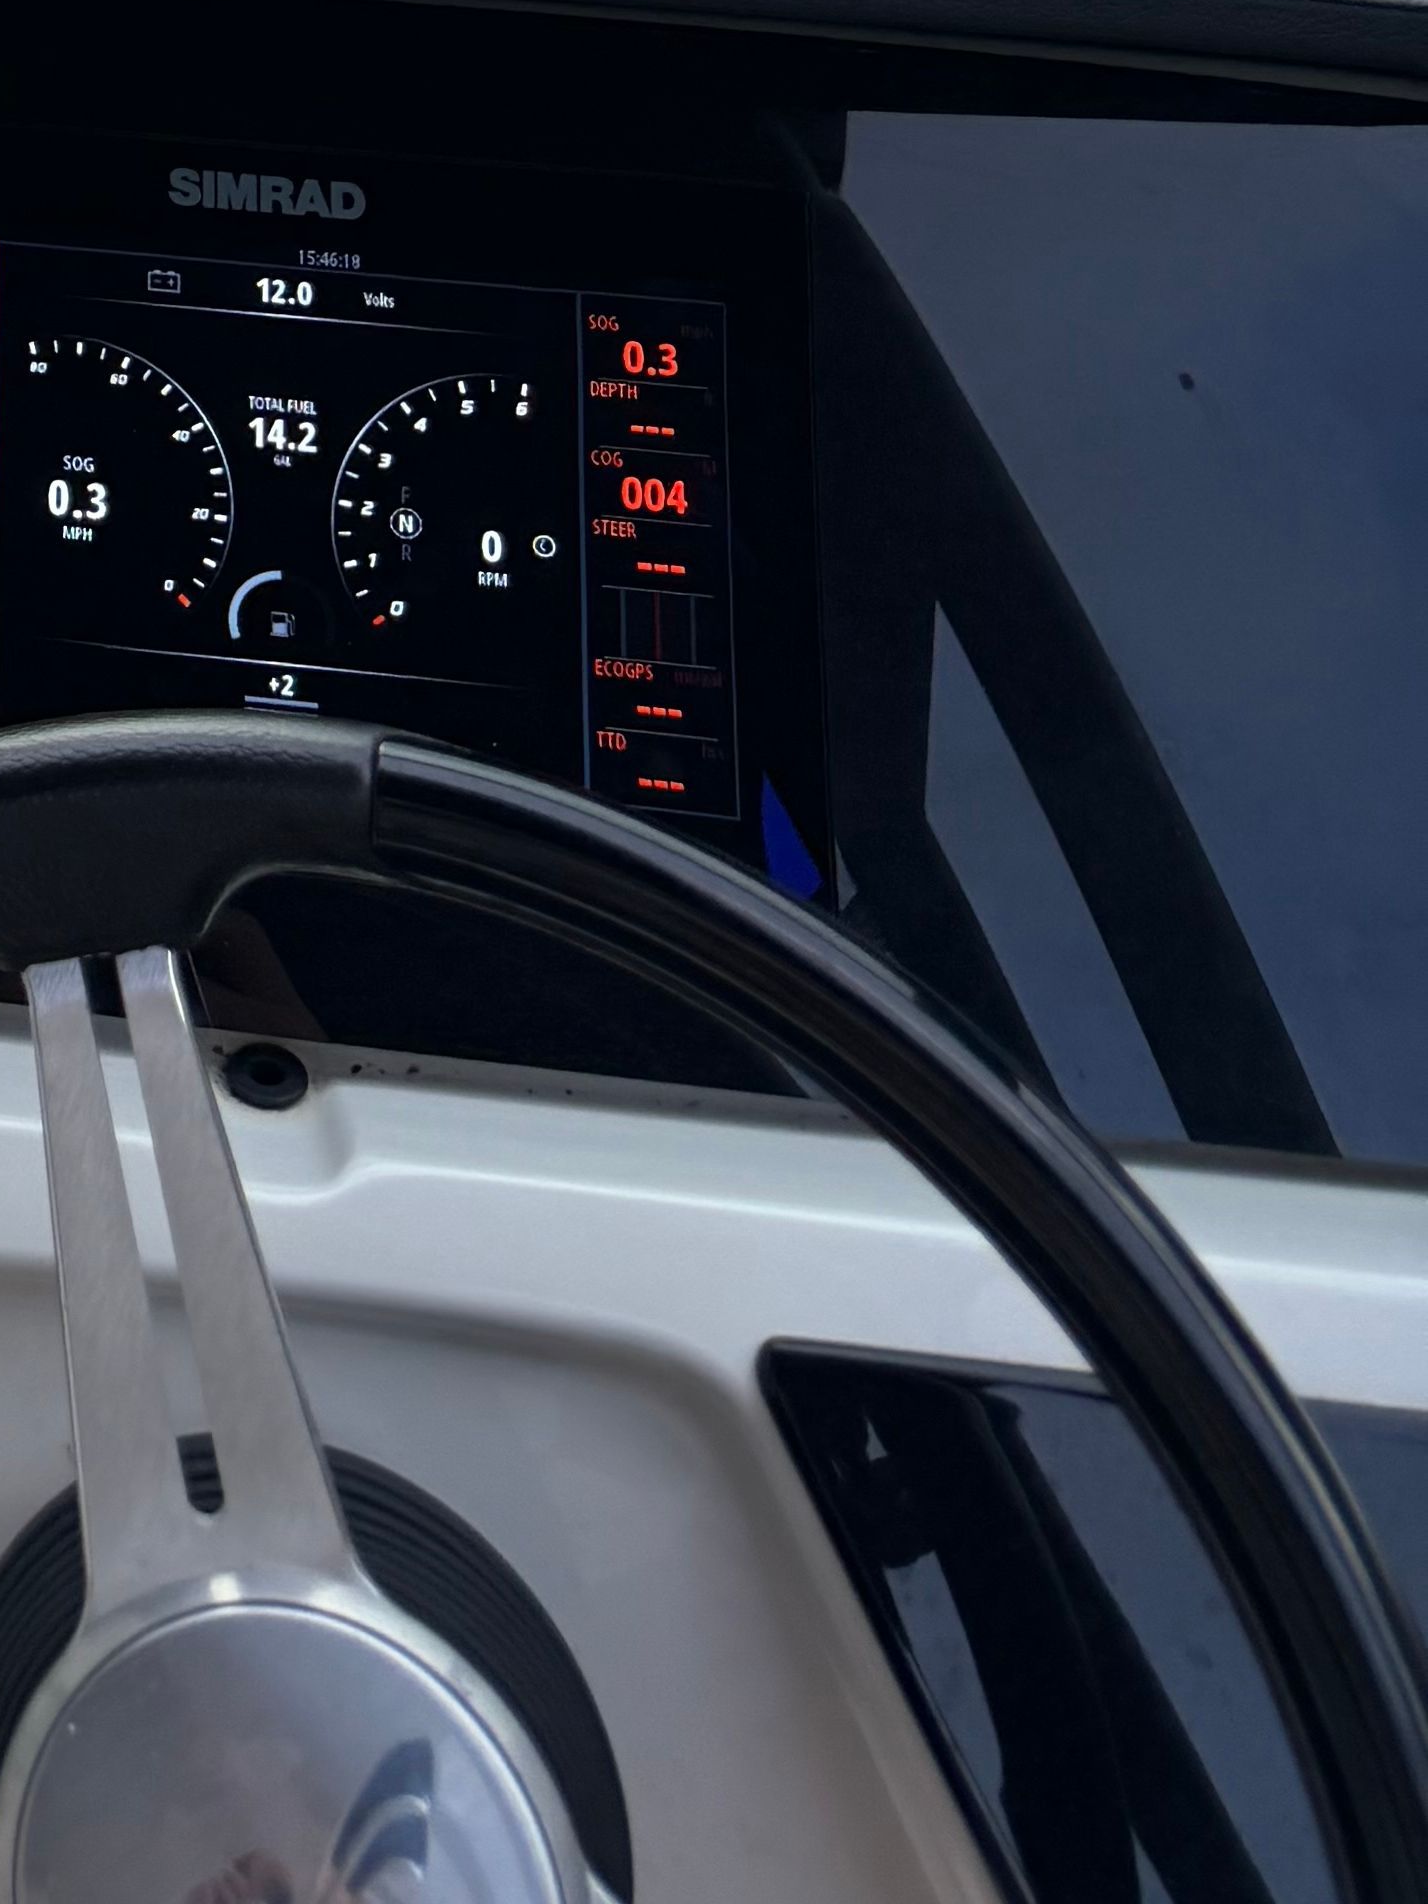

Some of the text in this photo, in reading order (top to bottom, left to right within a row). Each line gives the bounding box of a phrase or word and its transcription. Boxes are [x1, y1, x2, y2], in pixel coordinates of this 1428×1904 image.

[167, 167, 367, 220] SIMRAD
[299, 249, 361, 270] 15:46:18
[255, 277, 395, 309] 12.0 Volts
[588, 313, 620, 333] SOG
[622, 340, 679, 377] 0.3
[109, 373, 129, 386] 60
[590, 380, 639, 400] DEPTH
[248, 394, 318, 416] TOTAL FUEL
[460, 399, 475, 416] 5
[515, 400, 529, 417] 6
[247, 416, 319, 454] 14.2
[413, 417, 428, 433] 4
[171, 429, 191, 443] 40
[62, 454, 95, 473] SOG
[378, 452, 392, 469] 3
[590, 449, 624, 468] COG
[47, 478, 108, 520] 0.3
[621, 476, 688, 515] 004
[191, 508, 210, 521] 20
[360, 500, 375, 517] 2
[62, 524, 94, 542] MPH
[397, 513, 415, 534] N
[592, 518, 637, 539] STEER
[480, 529, 503, 564] 0
[368, 552, 378, 568] 1
[163, 579, 175, 592] 0
[477, 570, 509, 589] RPM
[389, 600, 404, 617] 0
[594, 658, 655, 681] ECOGPS
[269, 673, 295, 697] +2
[595, 730, 628, 752] TTD
